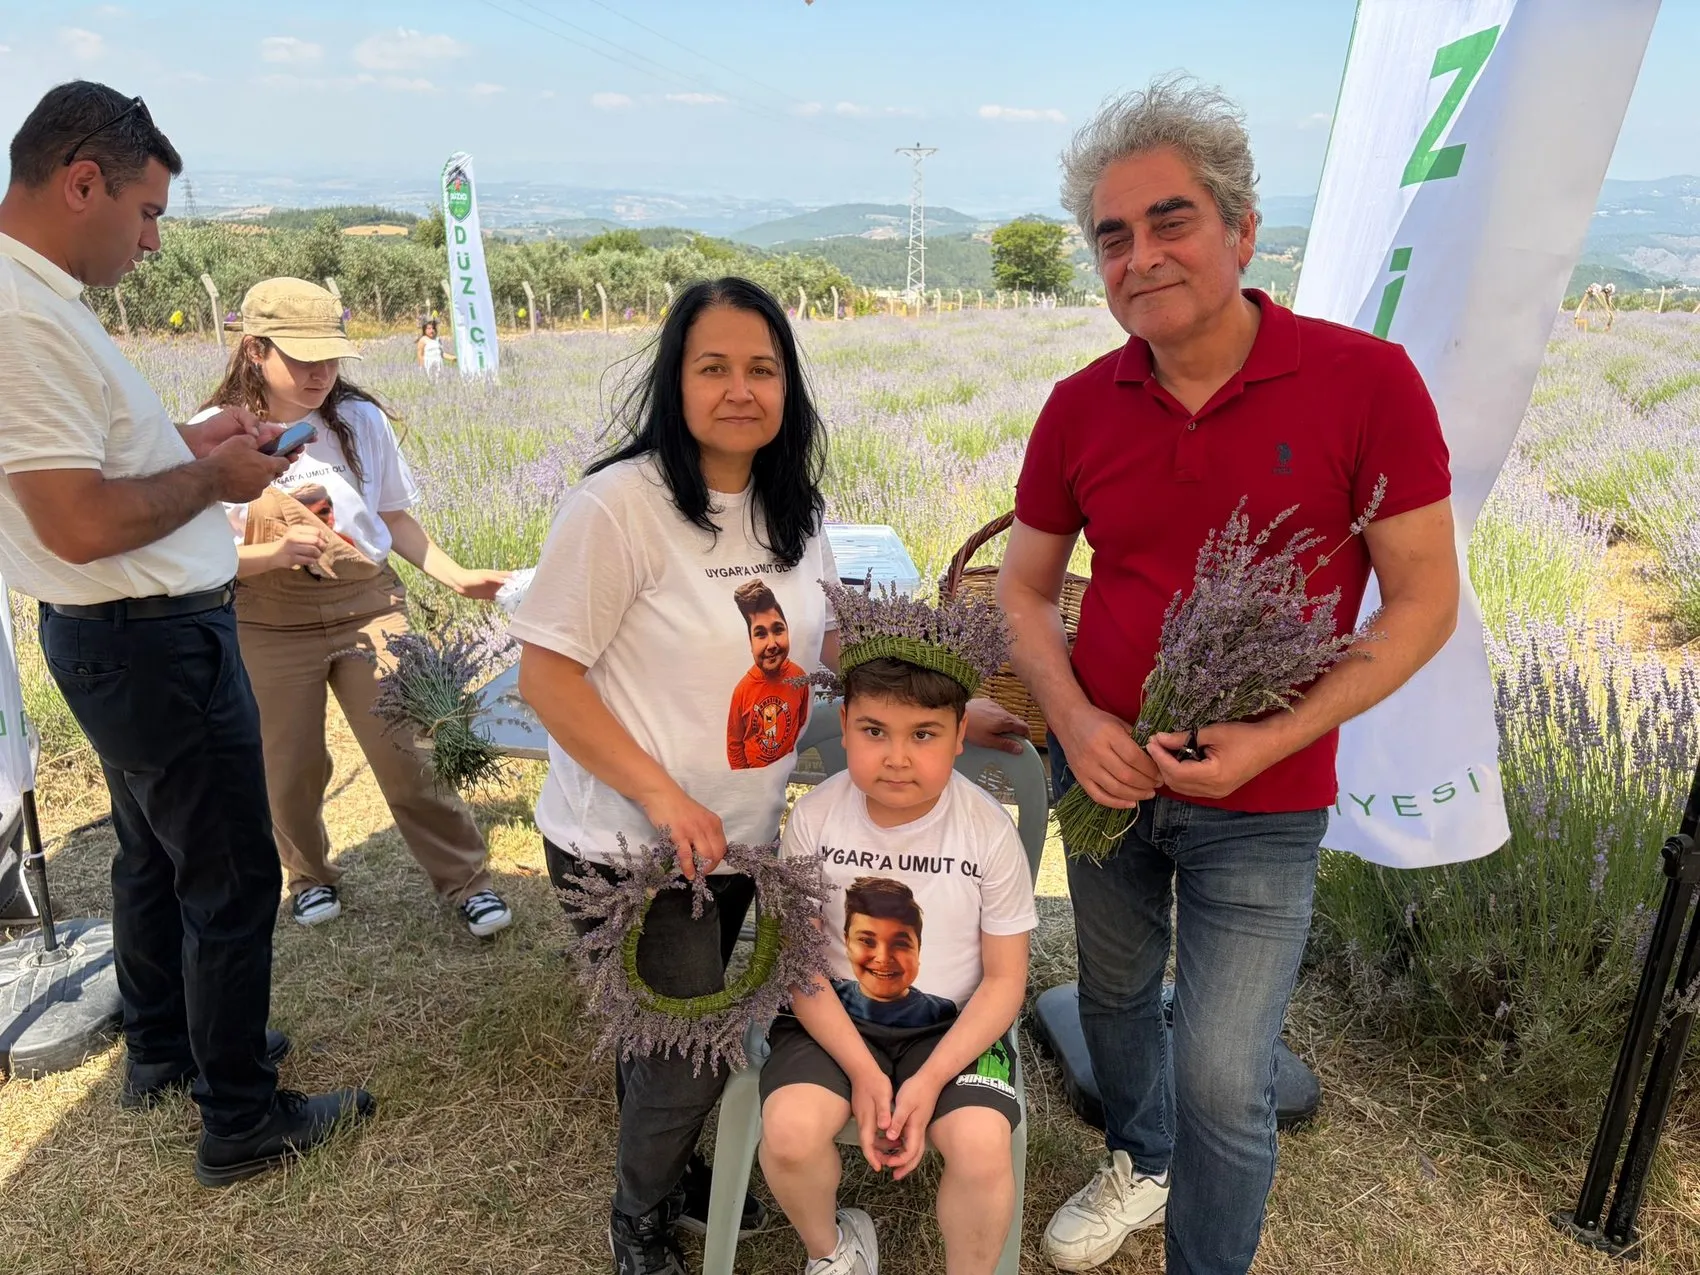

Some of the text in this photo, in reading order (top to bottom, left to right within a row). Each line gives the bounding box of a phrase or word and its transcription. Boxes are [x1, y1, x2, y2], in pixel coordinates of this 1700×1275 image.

[454, 225, 485, 369] DÜZİÇİ
[306, 467, 329, 478] UMUT
[705, 566, 751, 578] UYGAR'A
[898, 854, 955, 874] UMUT
